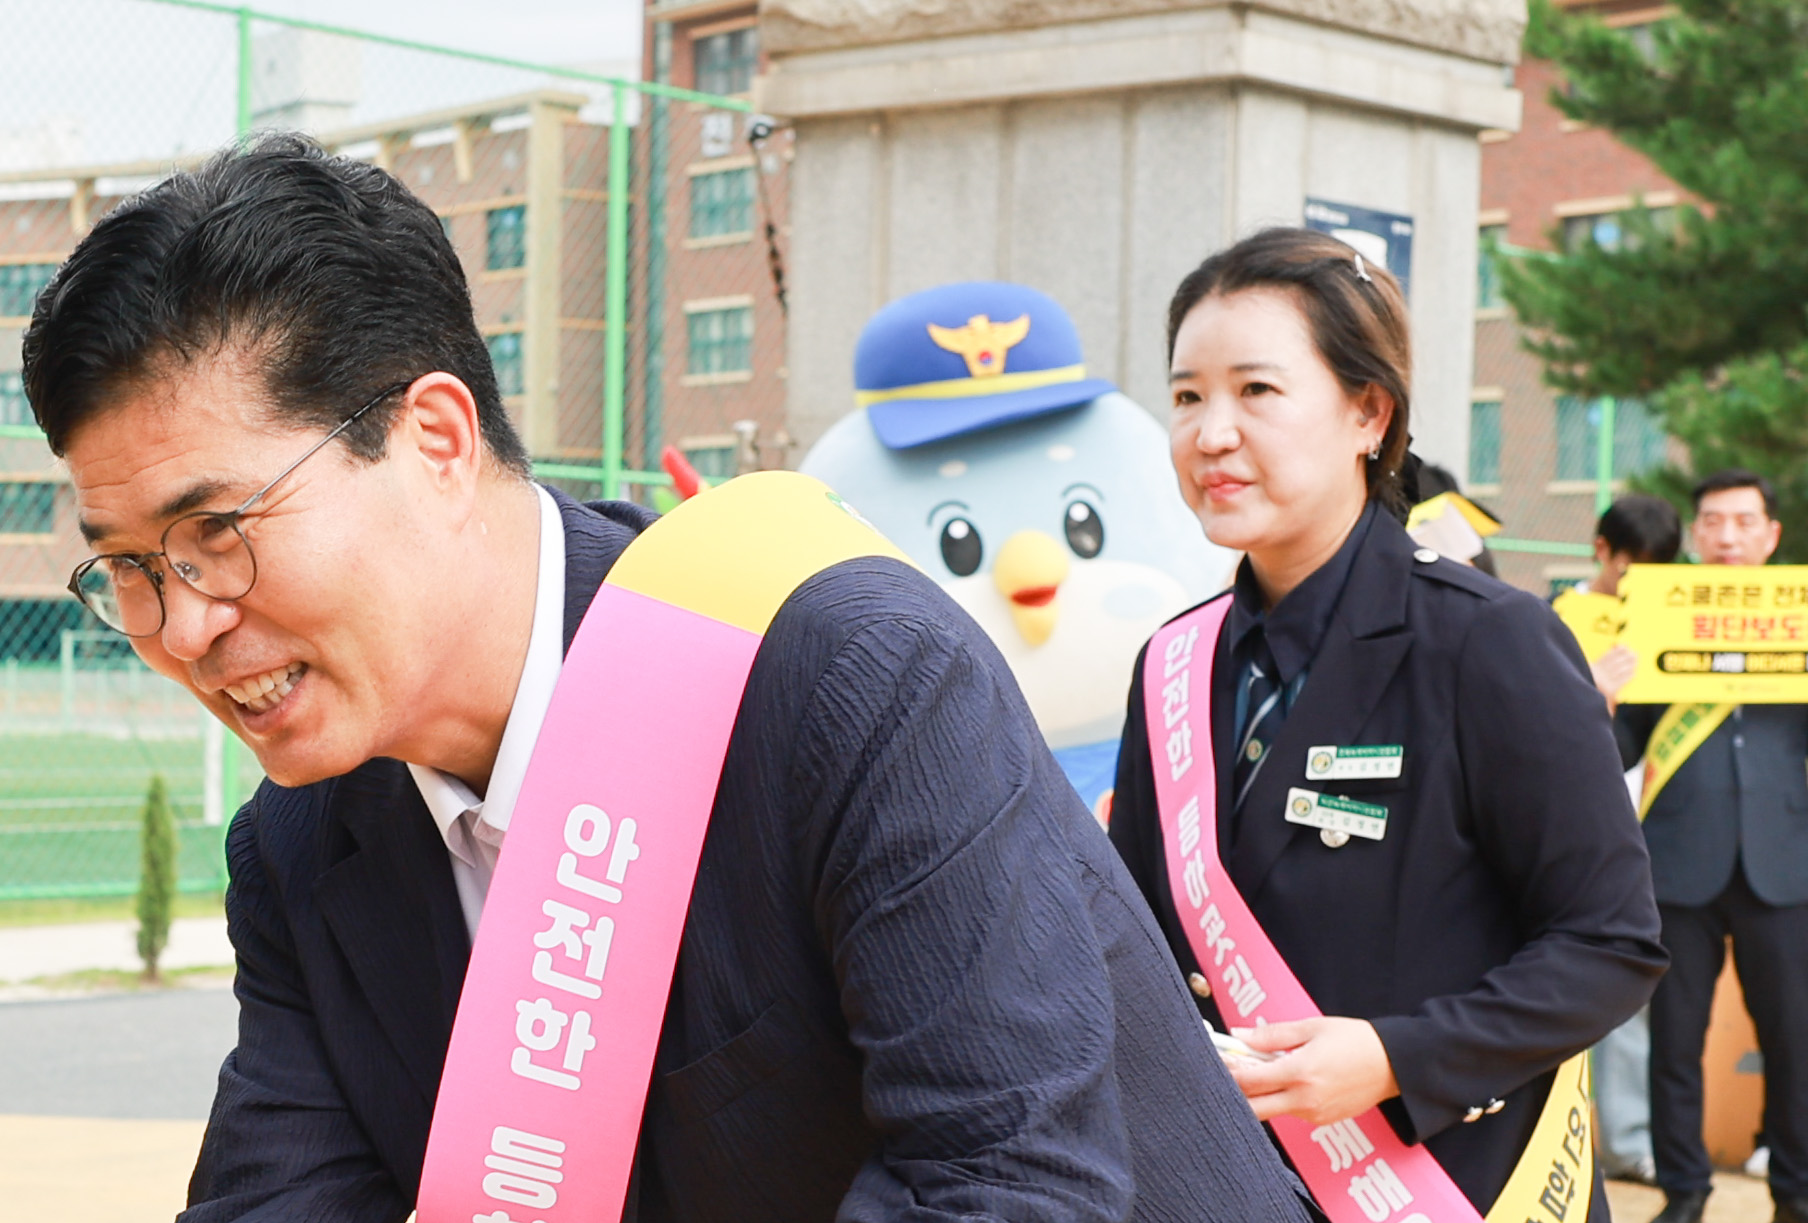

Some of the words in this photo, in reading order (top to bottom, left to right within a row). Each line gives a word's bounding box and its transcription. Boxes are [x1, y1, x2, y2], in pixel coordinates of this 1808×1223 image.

[1666, 584, 1763, 608] 스쿨존은
[1692, 615, 1804, 641] 횡단보도
[1161, 625, 1200, 782] 안전한
[510, 803, 640, 1091] 안전한
